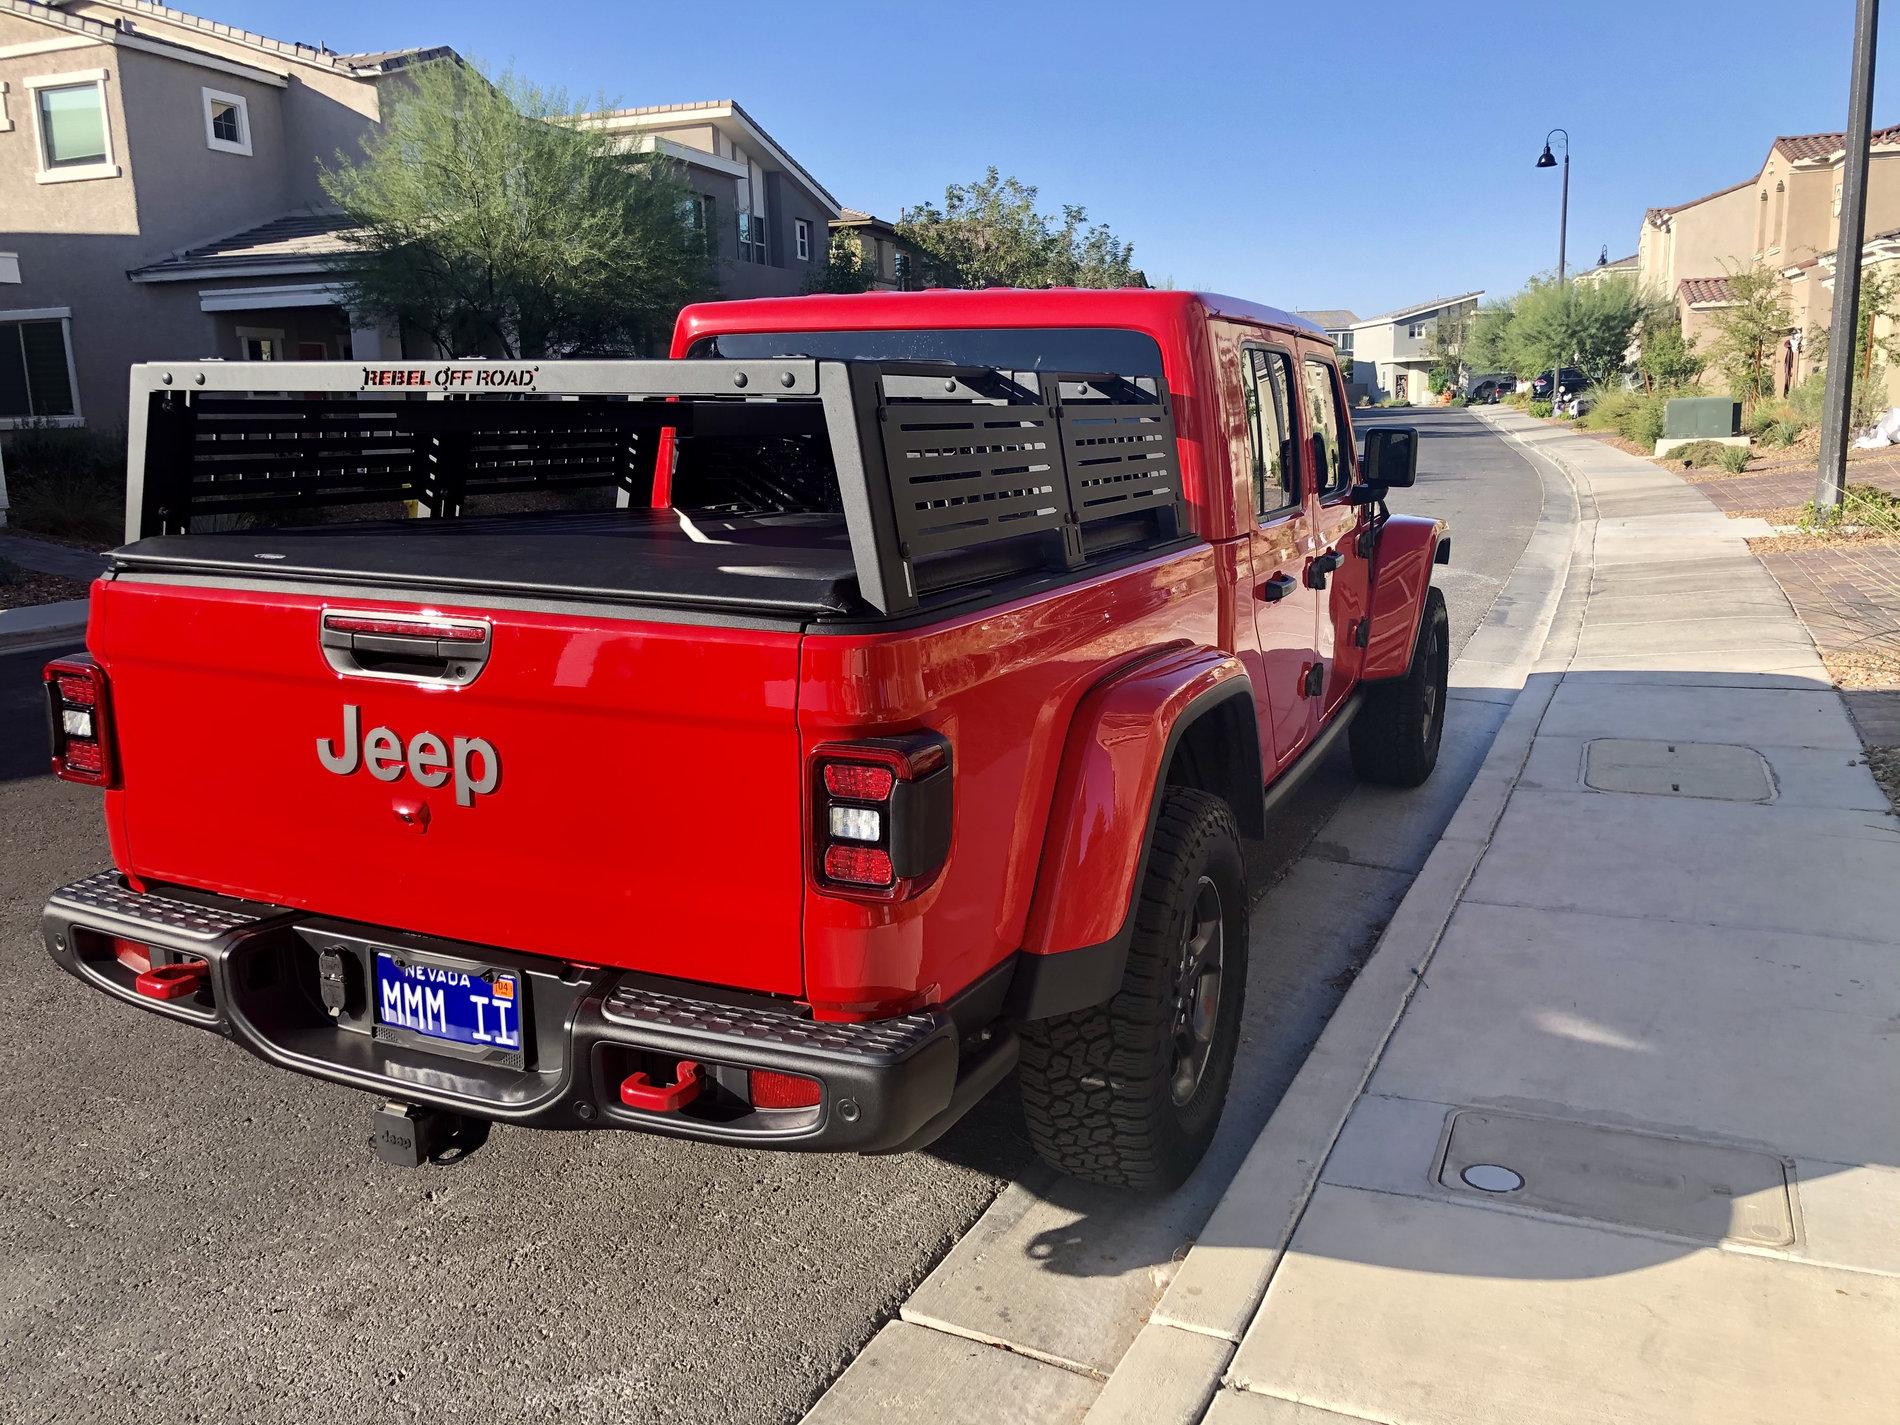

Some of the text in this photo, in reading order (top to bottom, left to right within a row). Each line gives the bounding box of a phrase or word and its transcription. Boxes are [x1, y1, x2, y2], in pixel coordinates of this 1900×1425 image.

[364, 370, 534, 387] REBEL OFF ROAD
[316, 704, 500, 807] Jeep
[405, 965, 471, 988] NEVADA
[382, 979, 515, 1046] MMM II
